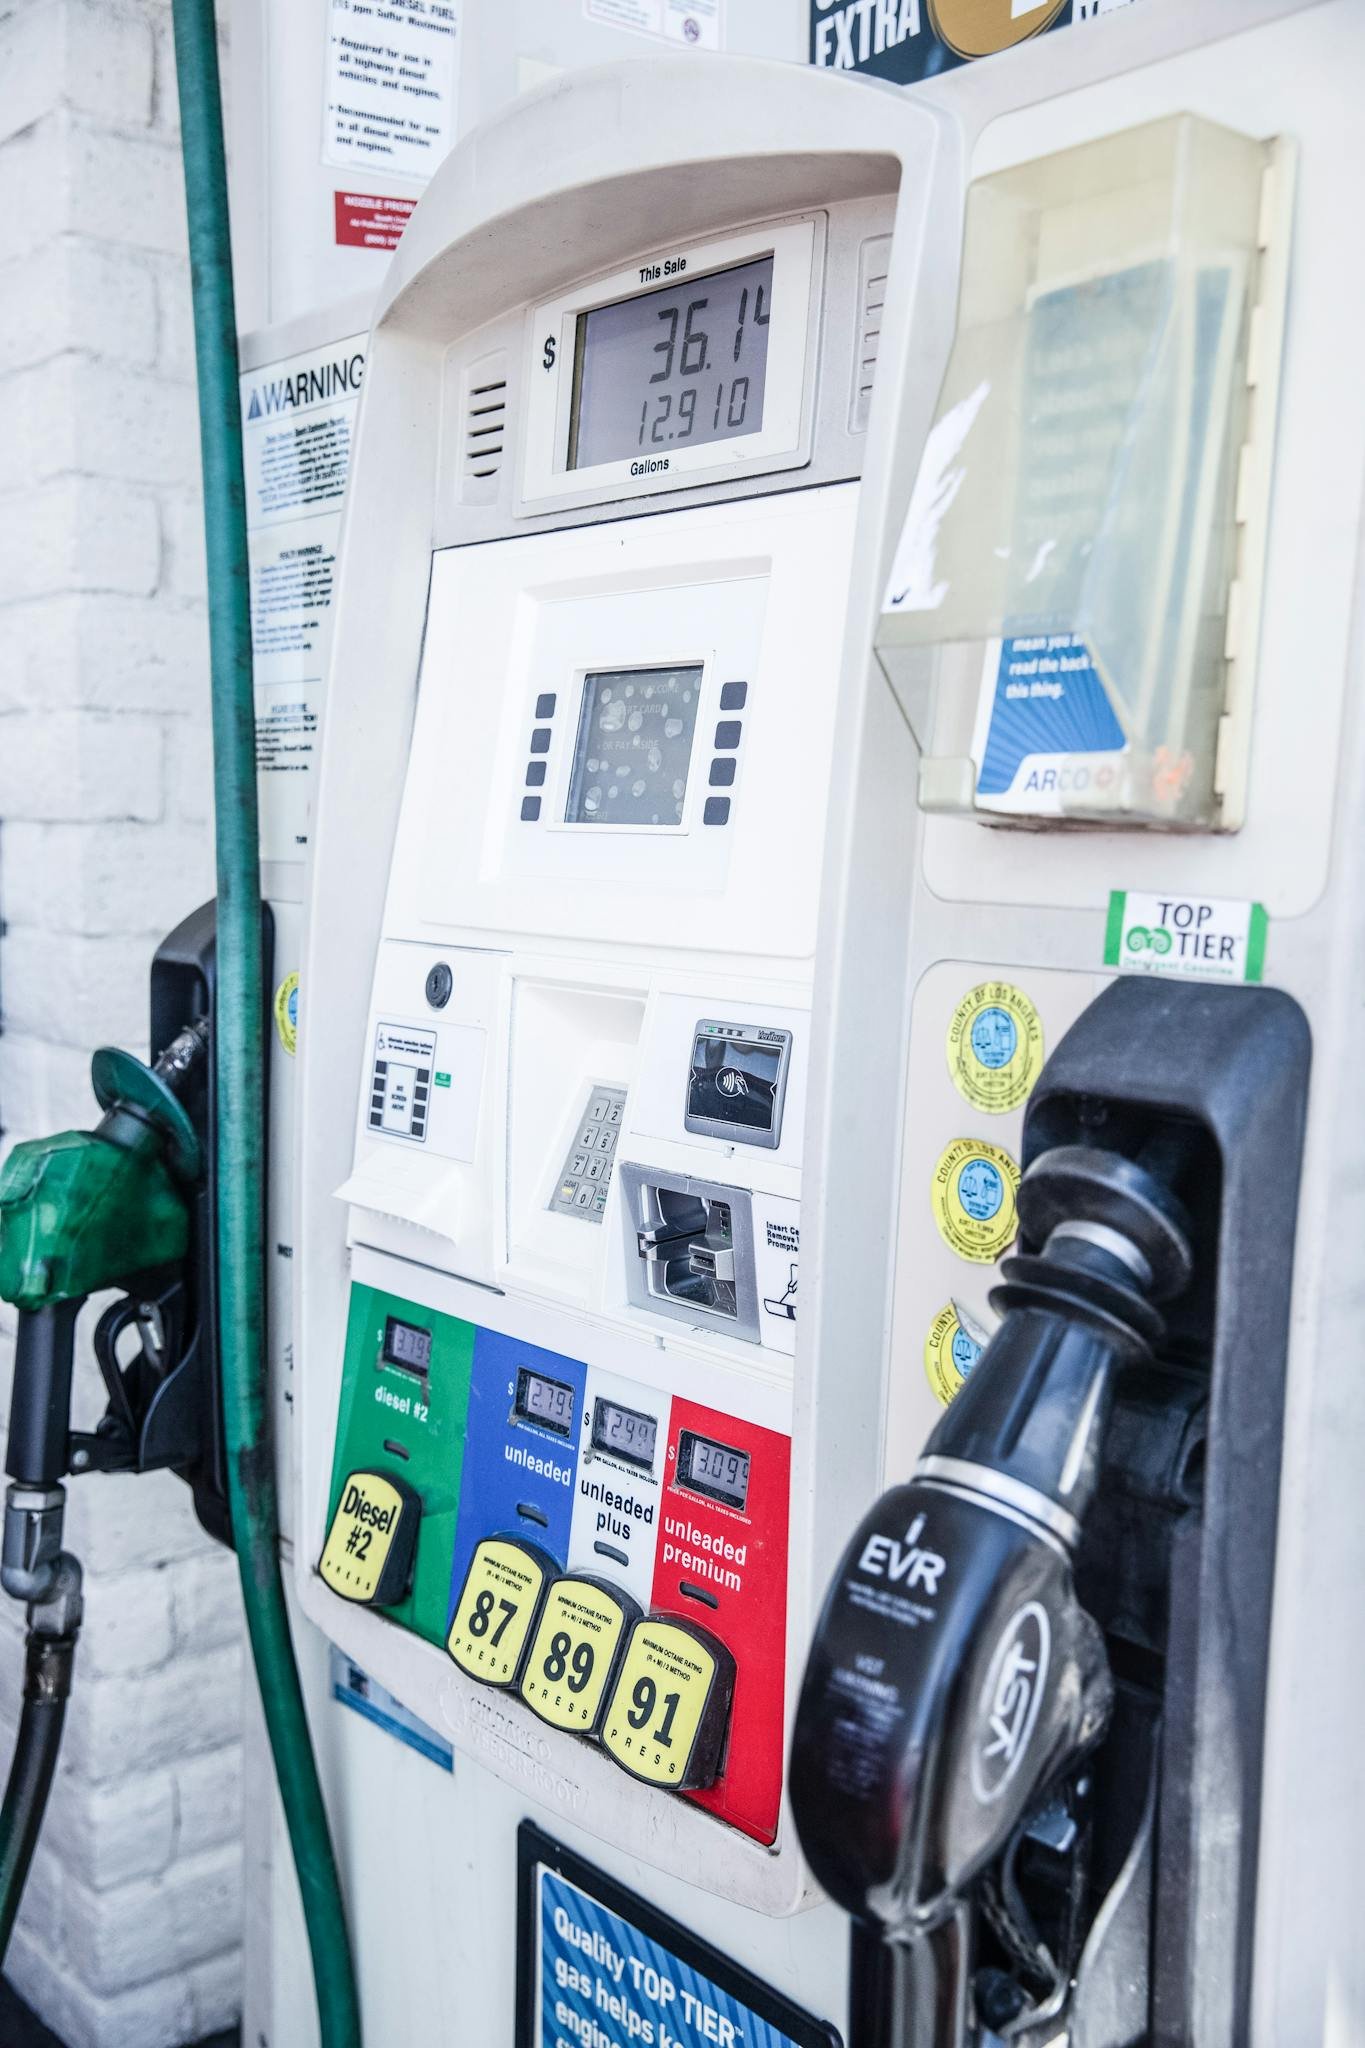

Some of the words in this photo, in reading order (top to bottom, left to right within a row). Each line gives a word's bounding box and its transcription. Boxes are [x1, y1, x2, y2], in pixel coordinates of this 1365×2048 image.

[815, 0, 921, 70] EXTRA
[639, 266, 661, 284] This
[664, 257, 687, 276] Sale
[543, 334, 556, 372] $
[263, 354, 365, 416] WARNING
[639, 376, 750, 446] 12.910
[630, 457, 670, 477] Gallons
[1024, 769, 1090, 793] ARCO
[1158, 902, 1213, 929] TOP
[951, 1000, 976, 1043] COUNTY
[1010, 994, 1040, 1042] ANGELES
[611, 1111, 619, 1121] 2
[583, 1135, 590, 1145] 4
[600, 1138, 607, 1149] 5
[573, 1161, 581, 1171] 7
[590, 1165, 597, 1176] 8
[936, 1145, 964, 1184] COUNTY
[580, 1193, 586, 1204] 0
[766, 1221, 788, 1233] Insert
[766, 1229, 796, 1244] Remove
[929, 1309, 955, 1349] COUNTY
[374, 1386, 411, 1415] diesel
[413, 1402, 428, 1423] #2
[507, 1381, 515, 1396] $
[583, 1412, 591, 1427] $
[504, 1445, 572, 1488] unleaded
[668, 1446, 675, 1460] $
[343, 1485, 397, 1535] Diesel
[581, 1479, 654, 1525] unleaded
[345, 1525, 373, 1562] #2
[597, 1512, 631, 1540] plus
[664, 1516, 747, 1566] unleaded
[663, 1542, 741, 1592] premium
[858, 1533, 947, 1596] EVR
[468, 1590, 519, 1649] 87
[543, 1631, 595, 1694] 89
[627, 1676, 681, 1749] 91
[554, 1906, 625, 1983] Quality
[629, 1955, 676, 2008] TOP
[555, 1956, 592, 1999] gas
[596, 1977, 655, 2045] helps
